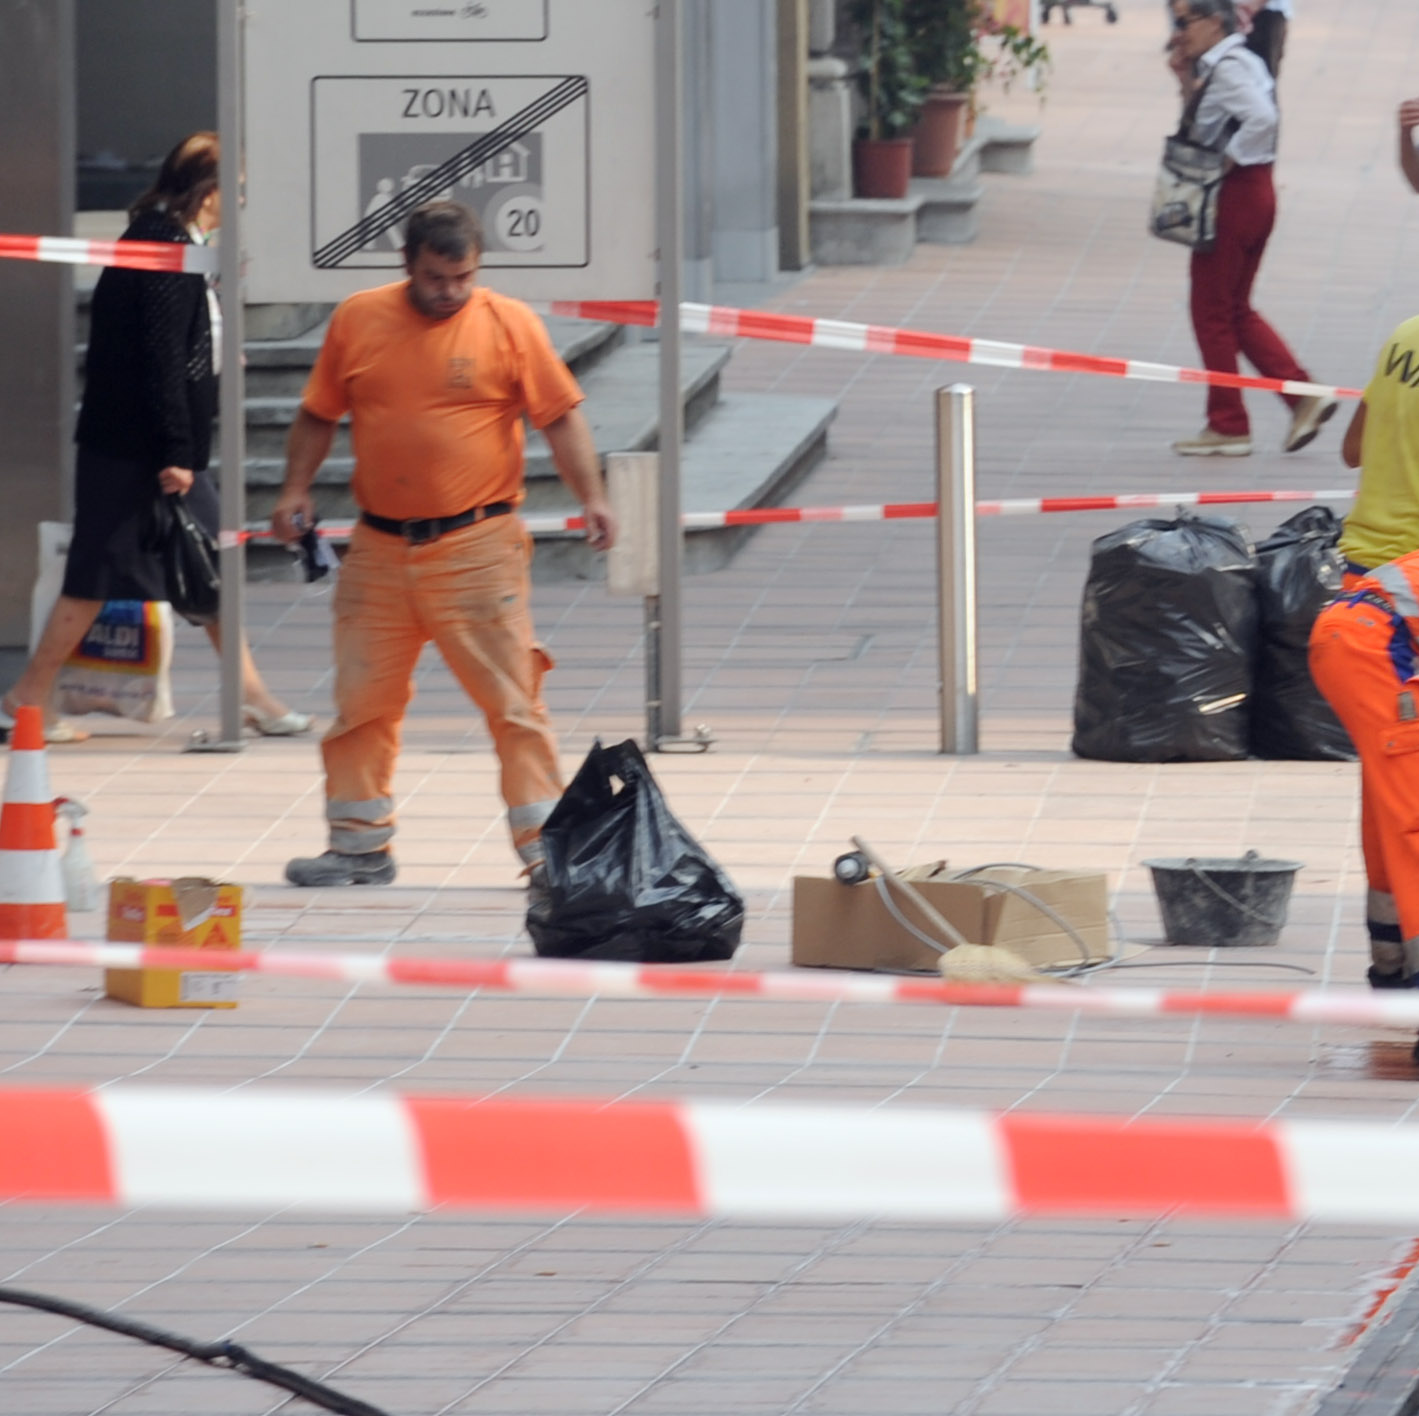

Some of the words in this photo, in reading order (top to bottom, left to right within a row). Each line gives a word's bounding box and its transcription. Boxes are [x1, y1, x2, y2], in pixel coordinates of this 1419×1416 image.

[402, 88, 497, 119] ZONA
[507, 209, 541, 238] 20
[87, 624, 140, 646] ALDI
